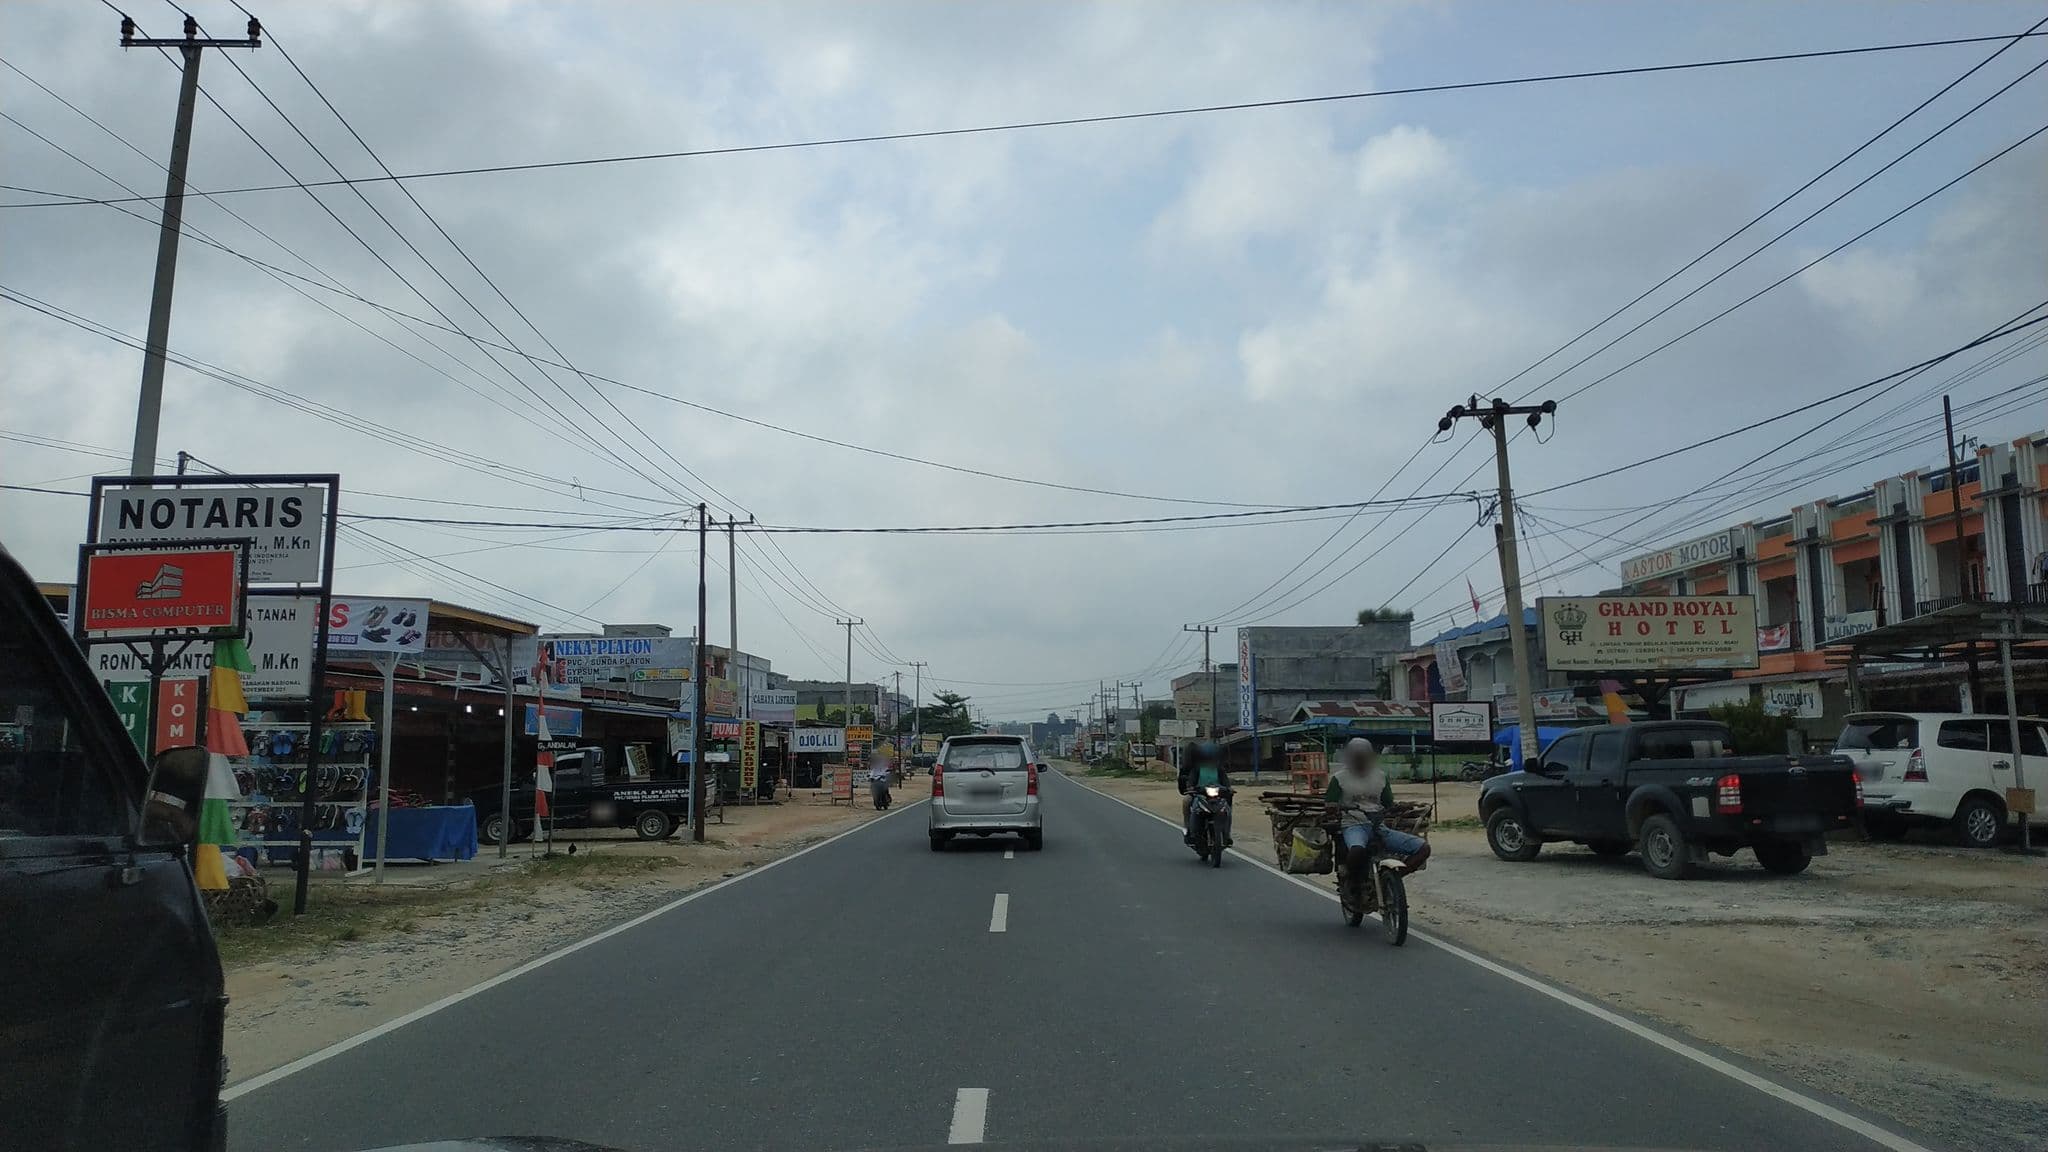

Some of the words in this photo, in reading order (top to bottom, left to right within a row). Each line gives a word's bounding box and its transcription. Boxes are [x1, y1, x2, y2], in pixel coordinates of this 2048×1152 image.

[119, 496, 303, 530] NOTARIS
[1631, 551, 1672, 578] ASTON
[1680, 534, 1730, 564] MOTOR
[91, 608, 138, 620] BISMA
[142, 604, 225, 618] COMPUTER
[257, 609, 297, 621] TANAH
[1598, 601, 1667, 617] GRAND
[1673, 601, 1737, 616] ROYAL
[597, 638, 652, 655] PLAFON
[100, 653, 135, 670] RONI
[262, 653, 299, 669] M.Kn
[1241, 641, 1249, 682] ASTON
[567, 668, 600, 676] GYPSUM
[567, 676, 584, 684] GRC
[1242, 684, 1250, 726] MOTOR
